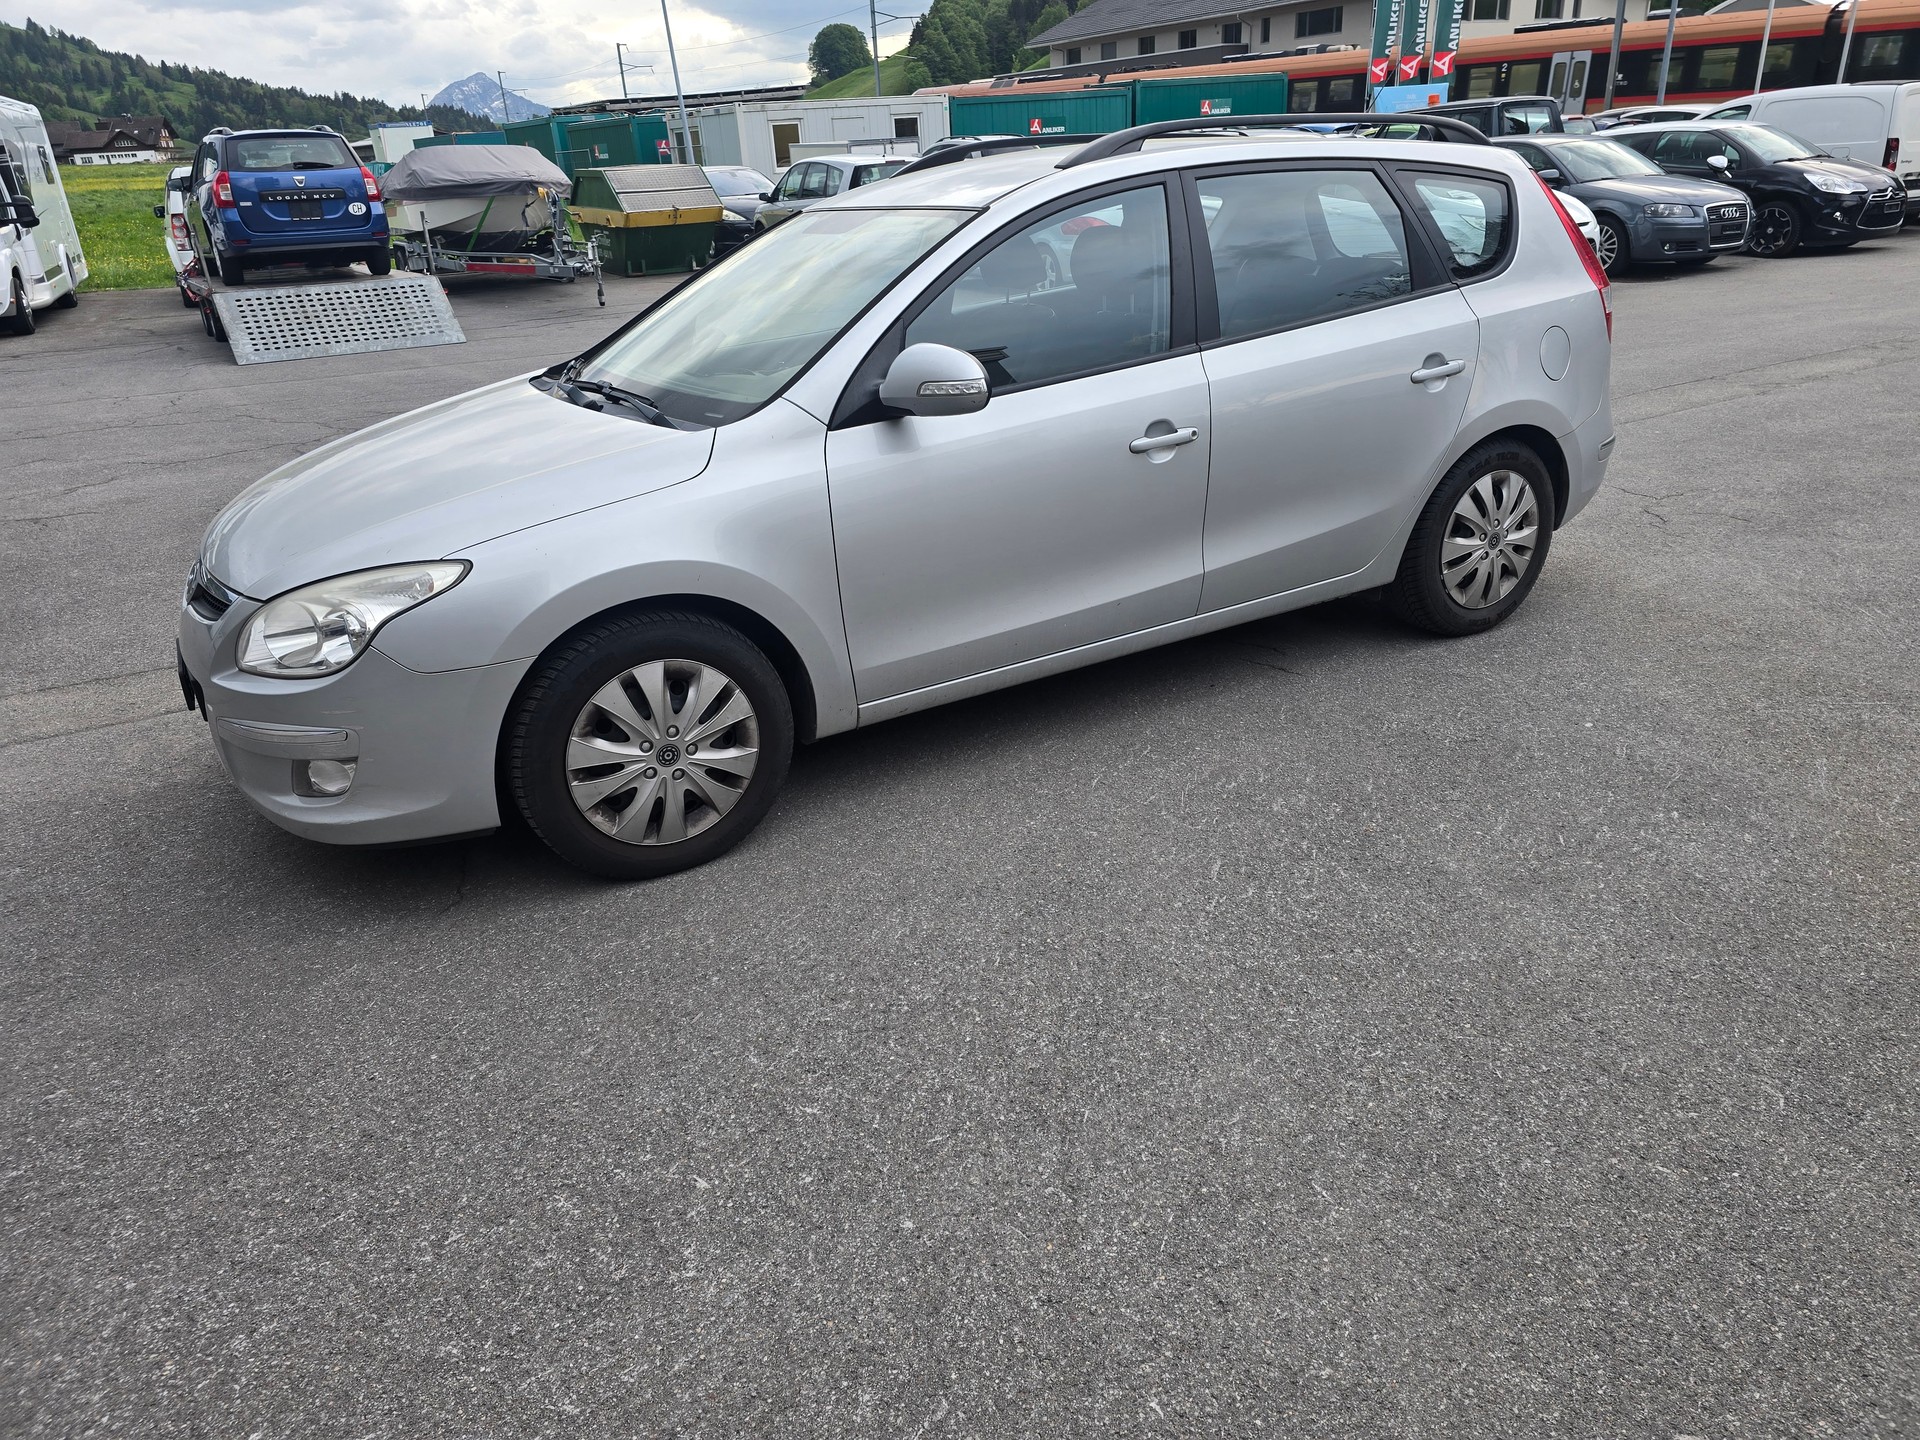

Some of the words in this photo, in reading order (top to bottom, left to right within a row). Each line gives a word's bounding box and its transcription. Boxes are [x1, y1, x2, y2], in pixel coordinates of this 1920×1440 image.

[1385, 0, 1400, 55] ANLIKE
[1448, 0, 1464, 50] ANLIK
[1501, 62, 1508, 72] 2
[352, 204, 363, 213] CH
